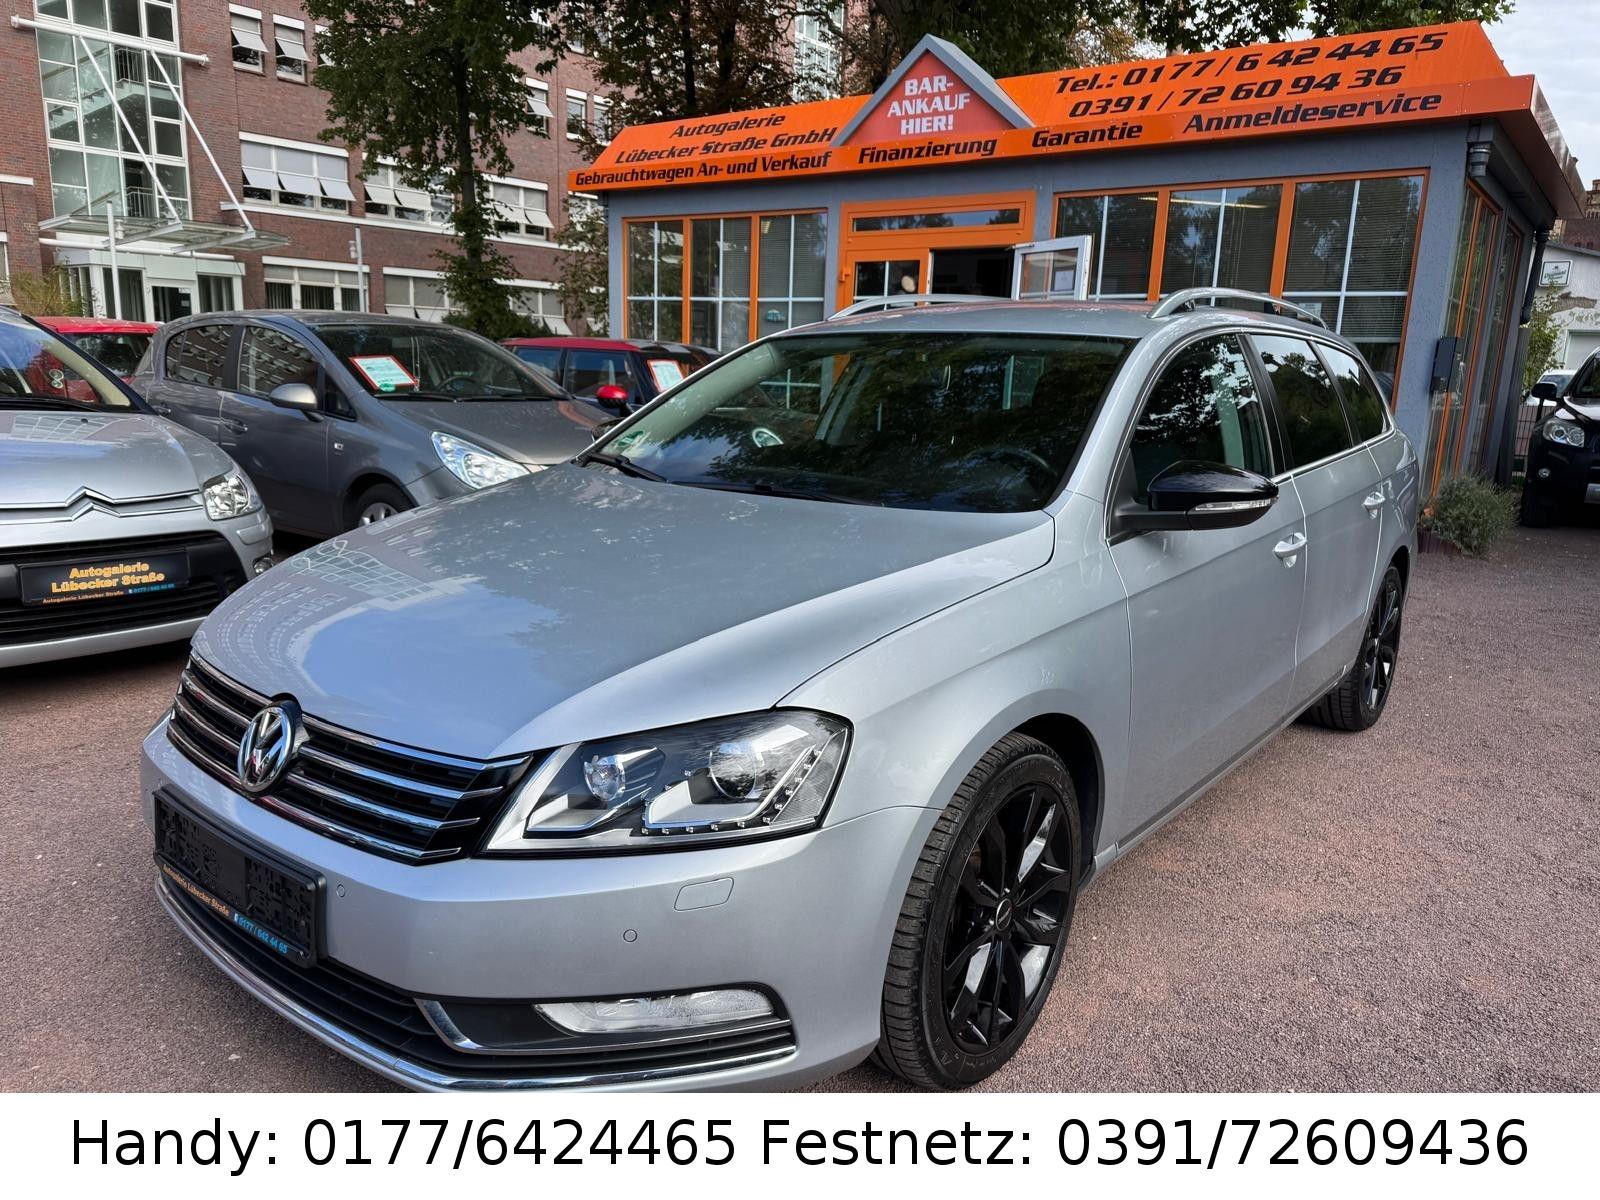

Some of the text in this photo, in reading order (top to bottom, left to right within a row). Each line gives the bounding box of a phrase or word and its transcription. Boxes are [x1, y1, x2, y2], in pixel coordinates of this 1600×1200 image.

[1056, 73, 1118, 94] Tel.:
[1267, 47, 1321, 67] 42
[1325, 39, 1383, 60] 44
[1387, 31, 1448, 56] 65
[904, 75, 954, 96] BAR-
[1179, 86, 1226, 106] 72
[1230, 79, 1283, 100] 60
[1286, 72, 1343, 95] 94
[1347, 65, 1406, 89] 36
[887, 93, 970, 117] ANKAUF
[1184, 93, 1442, 134] Anmeldeservice
[669, 113, 785, 139] Autogalerie
[900, 115, 954, 135] HIER!
[1032, 122, 1143, 149] Garantie
[615, 127, 838, 164] Lübecker Straße GmbH
[858, 138, 997, 164] Finanzierung
[576, 151, 832, 186] Gebrauchtwagen An- und Verkauf
[51, 572, 165, 594] Lübecker Straße
[69, 562, 150, 579] Autogalerie
